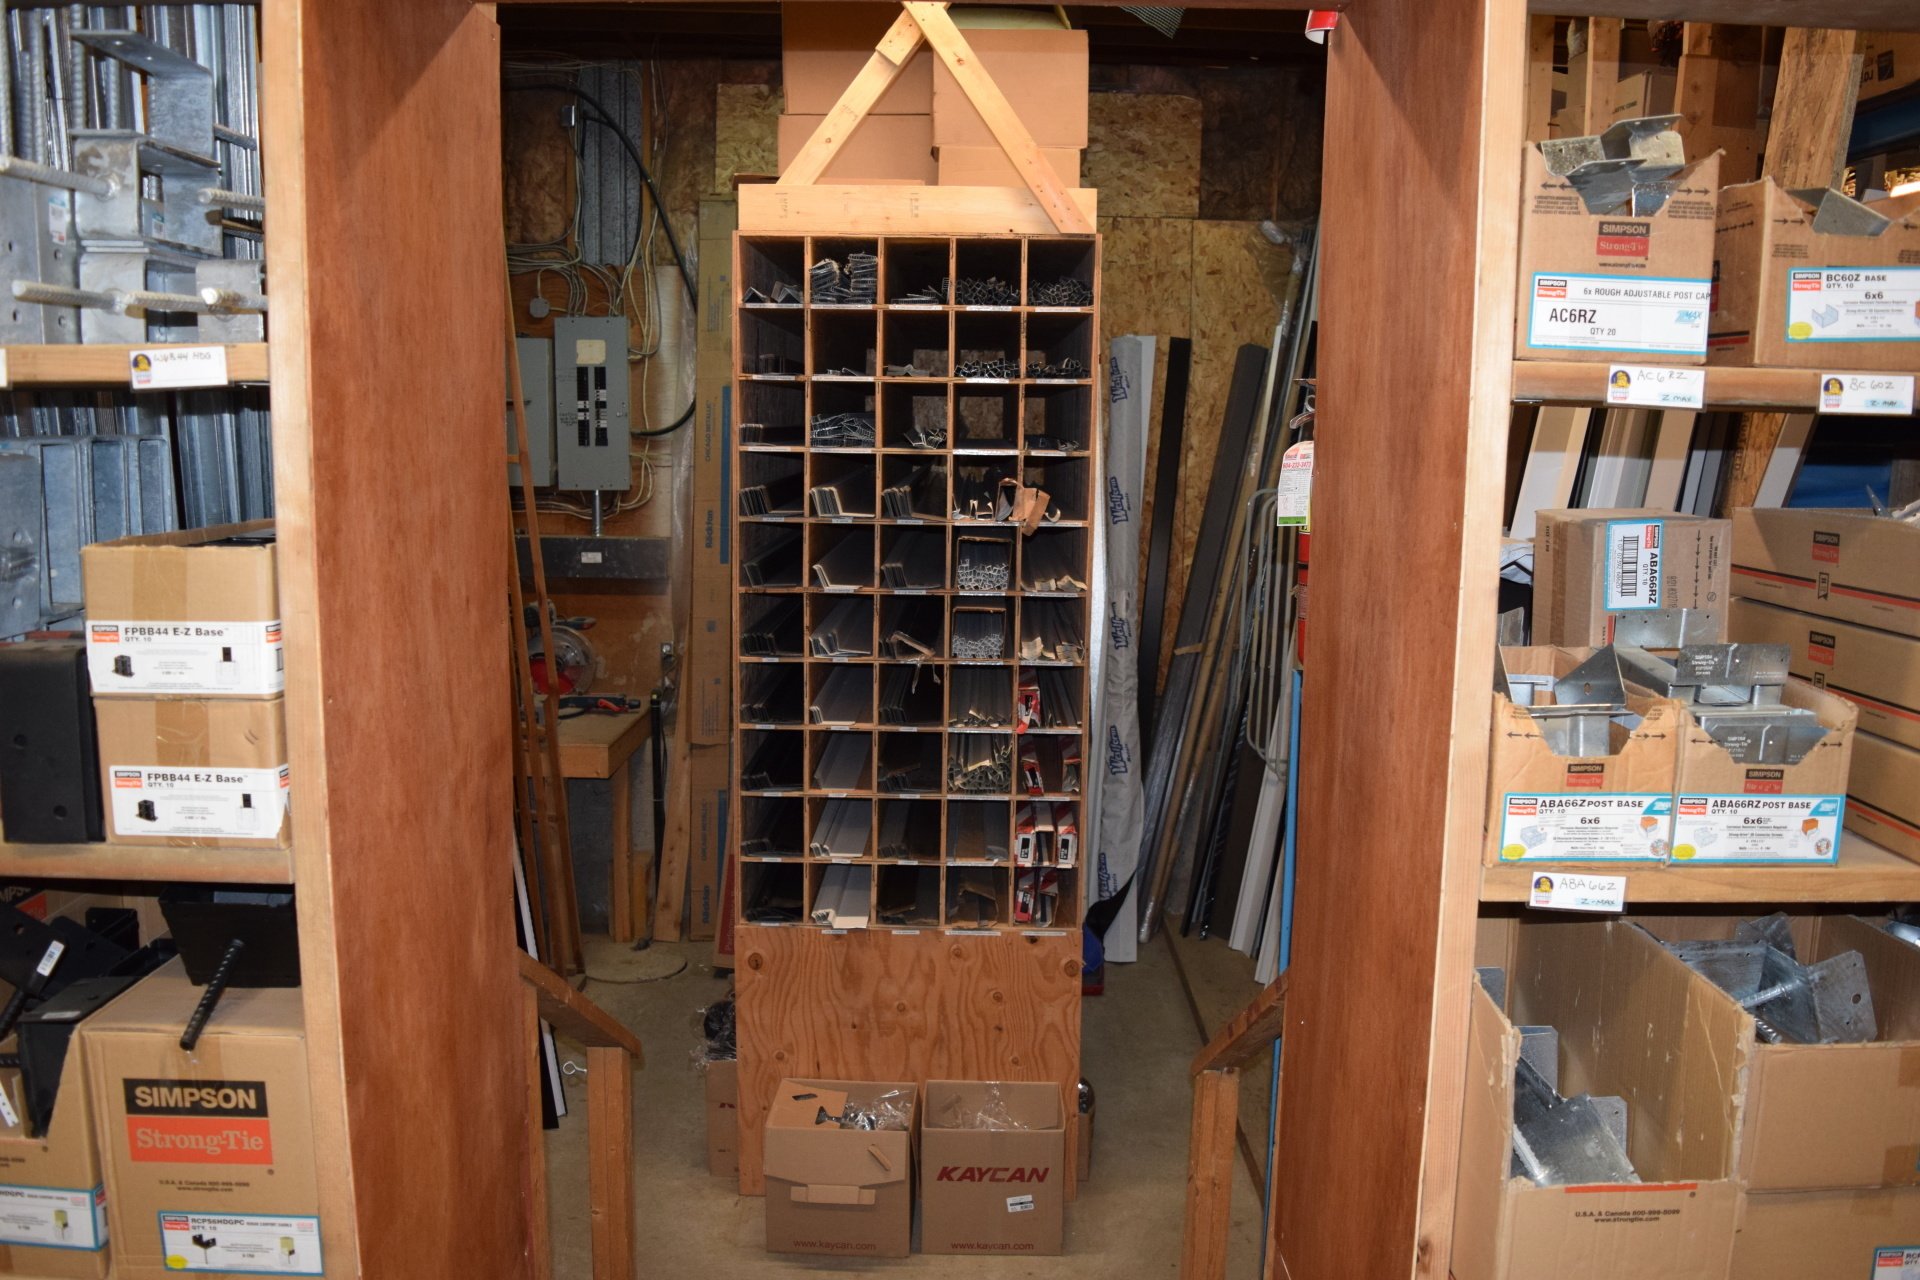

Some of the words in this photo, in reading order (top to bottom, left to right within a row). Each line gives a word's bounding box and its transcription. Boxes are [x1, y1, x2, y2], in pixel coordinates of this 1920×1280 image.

[1602, 224, 1647, 235] SIMPSON
[1826, 273, 1861, 282] BC60Z
[1583, 287, 1592, 295] 6x
[1594, 288, 1621, 297] ROUGH
[1624, 289, 1671, 299] ADJUSTABLE
[1674, 291, 1693, 300] POST
[1864, 291, 1884, 300] 6x6
[1549, 307, 1597, 324] AC6RZ
[1590, 327, 1604, 336] QTY
[1607, 328, 1616, 336] 20
[1815, 534, 1839, 545] SIMPSON
[1648, 552, 1659, 604] ABA66RZ
[124, 627, 169, 637] FPBB44
[173, 627, 191, 636] E-Z
[195, 628, 224, 637] Base
[1811, 633, 1835, 646] SIMPSON
[1570, 765, 1602, 773] SIMPSON
[1748, 770, 1782, 778] SIMPSON
[147, 773, 191, 782] FPBB44
[194, 773, 212, 783] E-Z
[216, 774, 244, 784] Base
[1539, 799, 1586, 808] ABA66Z
[1587, 800, 1614, 808] POST
[1617, 800, 1644, 808] BASE
[1712, 799, 1761, 808] ABA66RZ
[1762, 801, 1786, 809] POST
[1788, 801, 1811, 809] BASE
[1580, 816, 1600, 825] 6x6
[1743, 816, 1763, 825] 6x6
[135, 1085, 257, 1110] SIMPSON
[136, 1127, 264, 1155] Strong-Tie
[936, 1165, 1050, 1184] KAYCAN
[793, 1239, 877, 1251] www.kaycan.com
